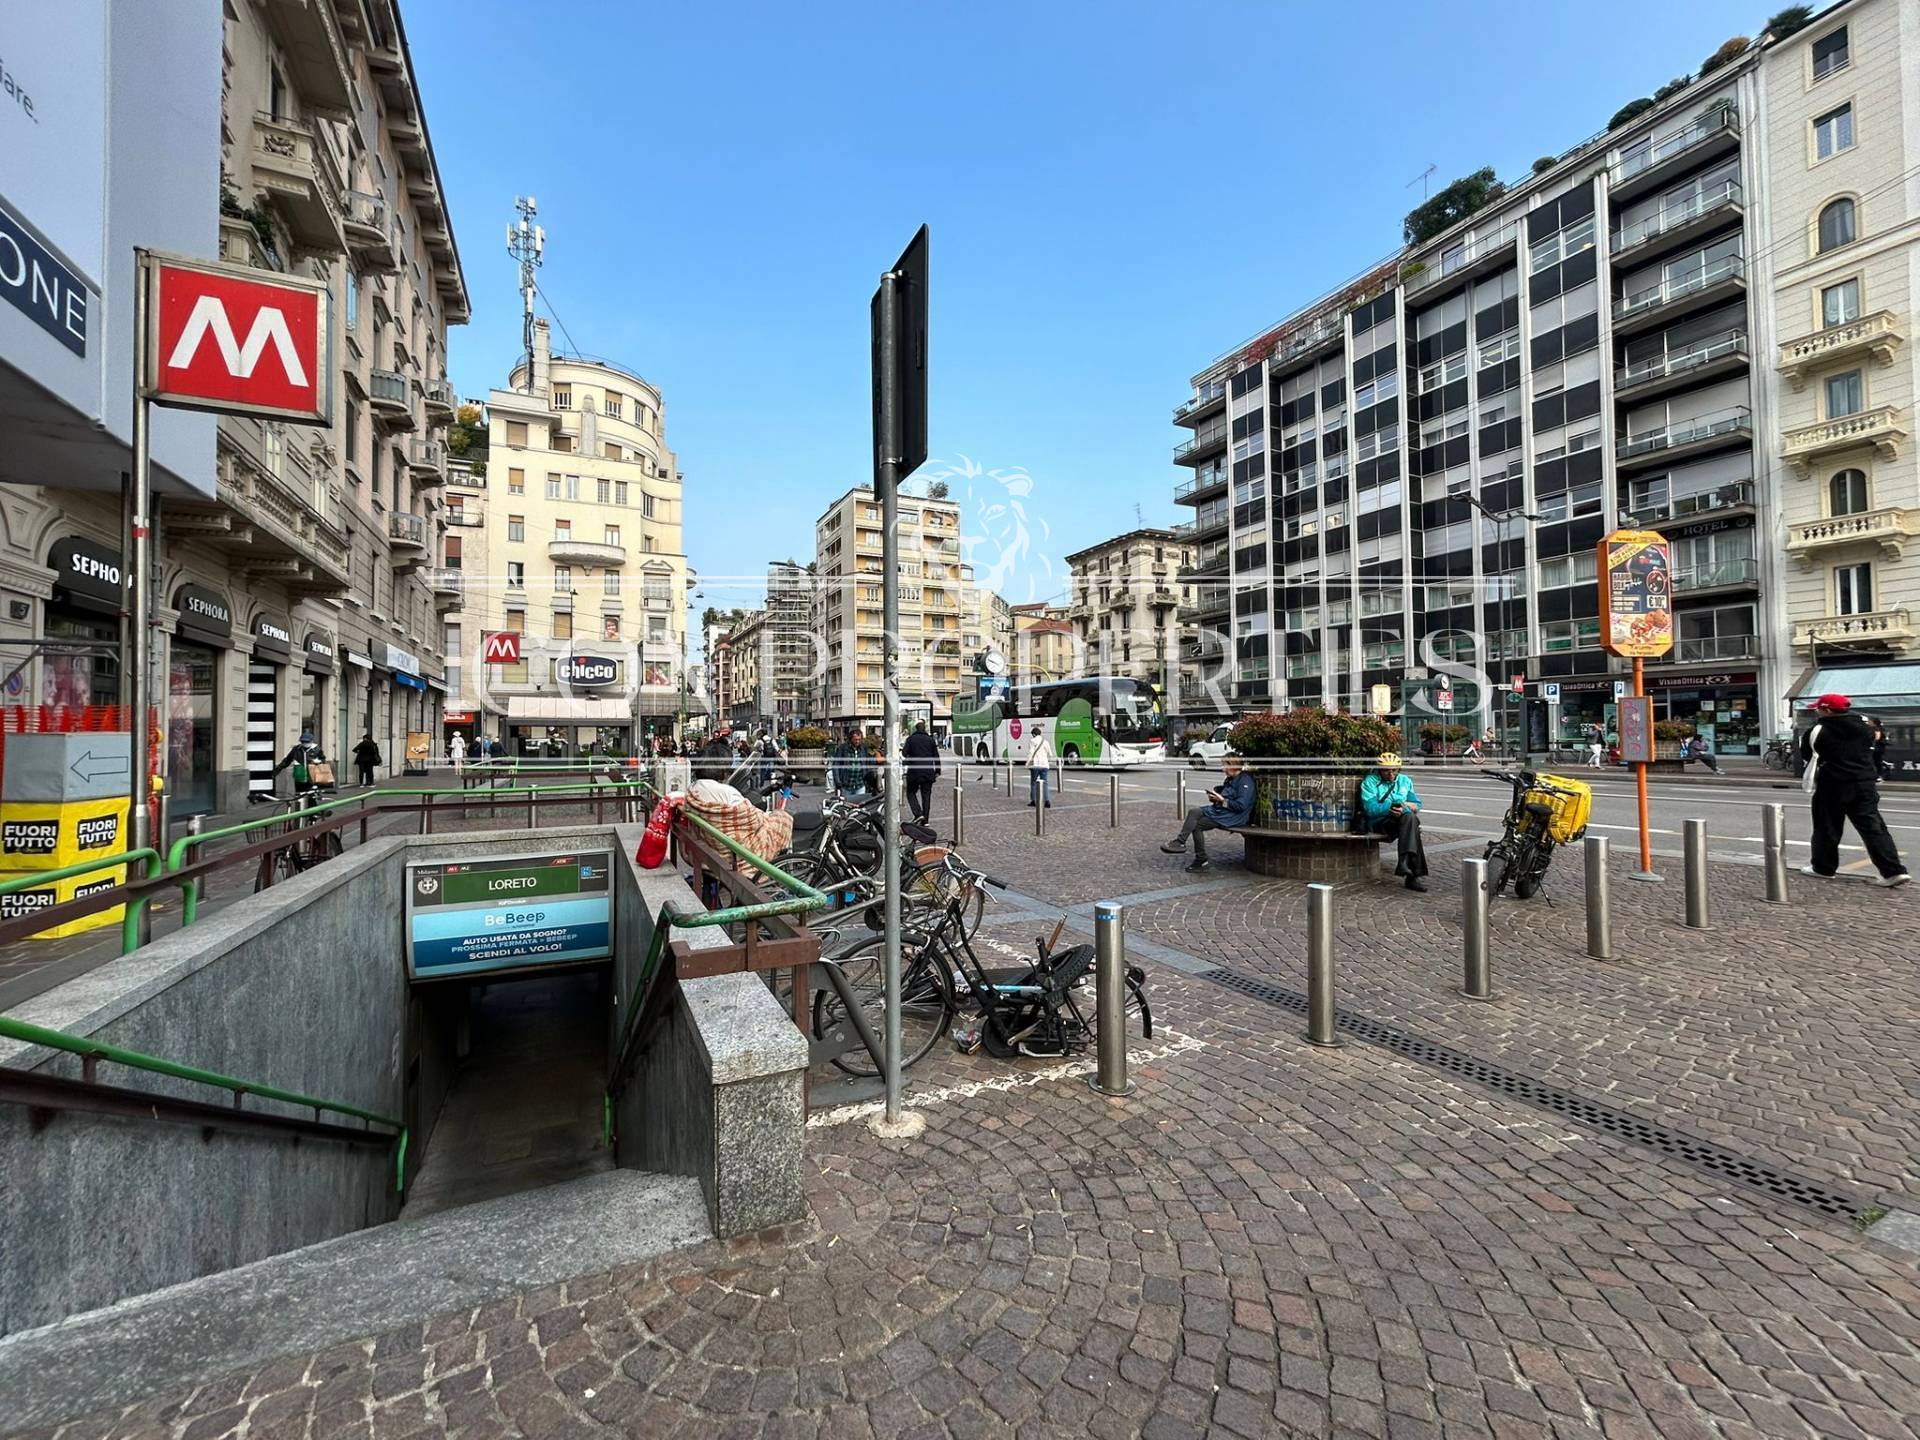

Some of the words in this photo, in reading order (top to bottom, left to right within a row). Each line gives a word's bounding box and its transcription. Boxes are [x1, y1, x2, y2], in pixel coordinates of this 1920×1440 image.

[167, 295, 310, 388] M
[1683, 520, 1729, 535] HOTEL
[188, 597, 229, 623] SEPHORA
[262, 623, 290, 643] SEPHORA
[488, 639, 517, 657] M
[560, 656, 614, 679] chicco
[1514, 679, 1522, 689] M
[1548, 685, 1556, 695] P
[4, 825, 57, 837] FUORI
[79, 819, 117, 834] FUORI
[4, 837, 56, 848] TUTTO
[79, 830, 116, 845] TUTTO
[488, 877, 537, 891] LORETO
[1, 895, 54, 906] FUORI
[485, 912, 546, 926] BeBeep
[463, 937, 488, 946] AUTO
[489, 934, 517, 942] USATA
[533, 928, 567, 938] SOGNO?
[451, 943, 497, 953] PROSSIMA
[499, 938, 538, 948] FERMATA
[469, 949, 511, 960] SCENDI
[513, 947, 527, 955] AL
[529, 943, 562, 953] VOLO!
